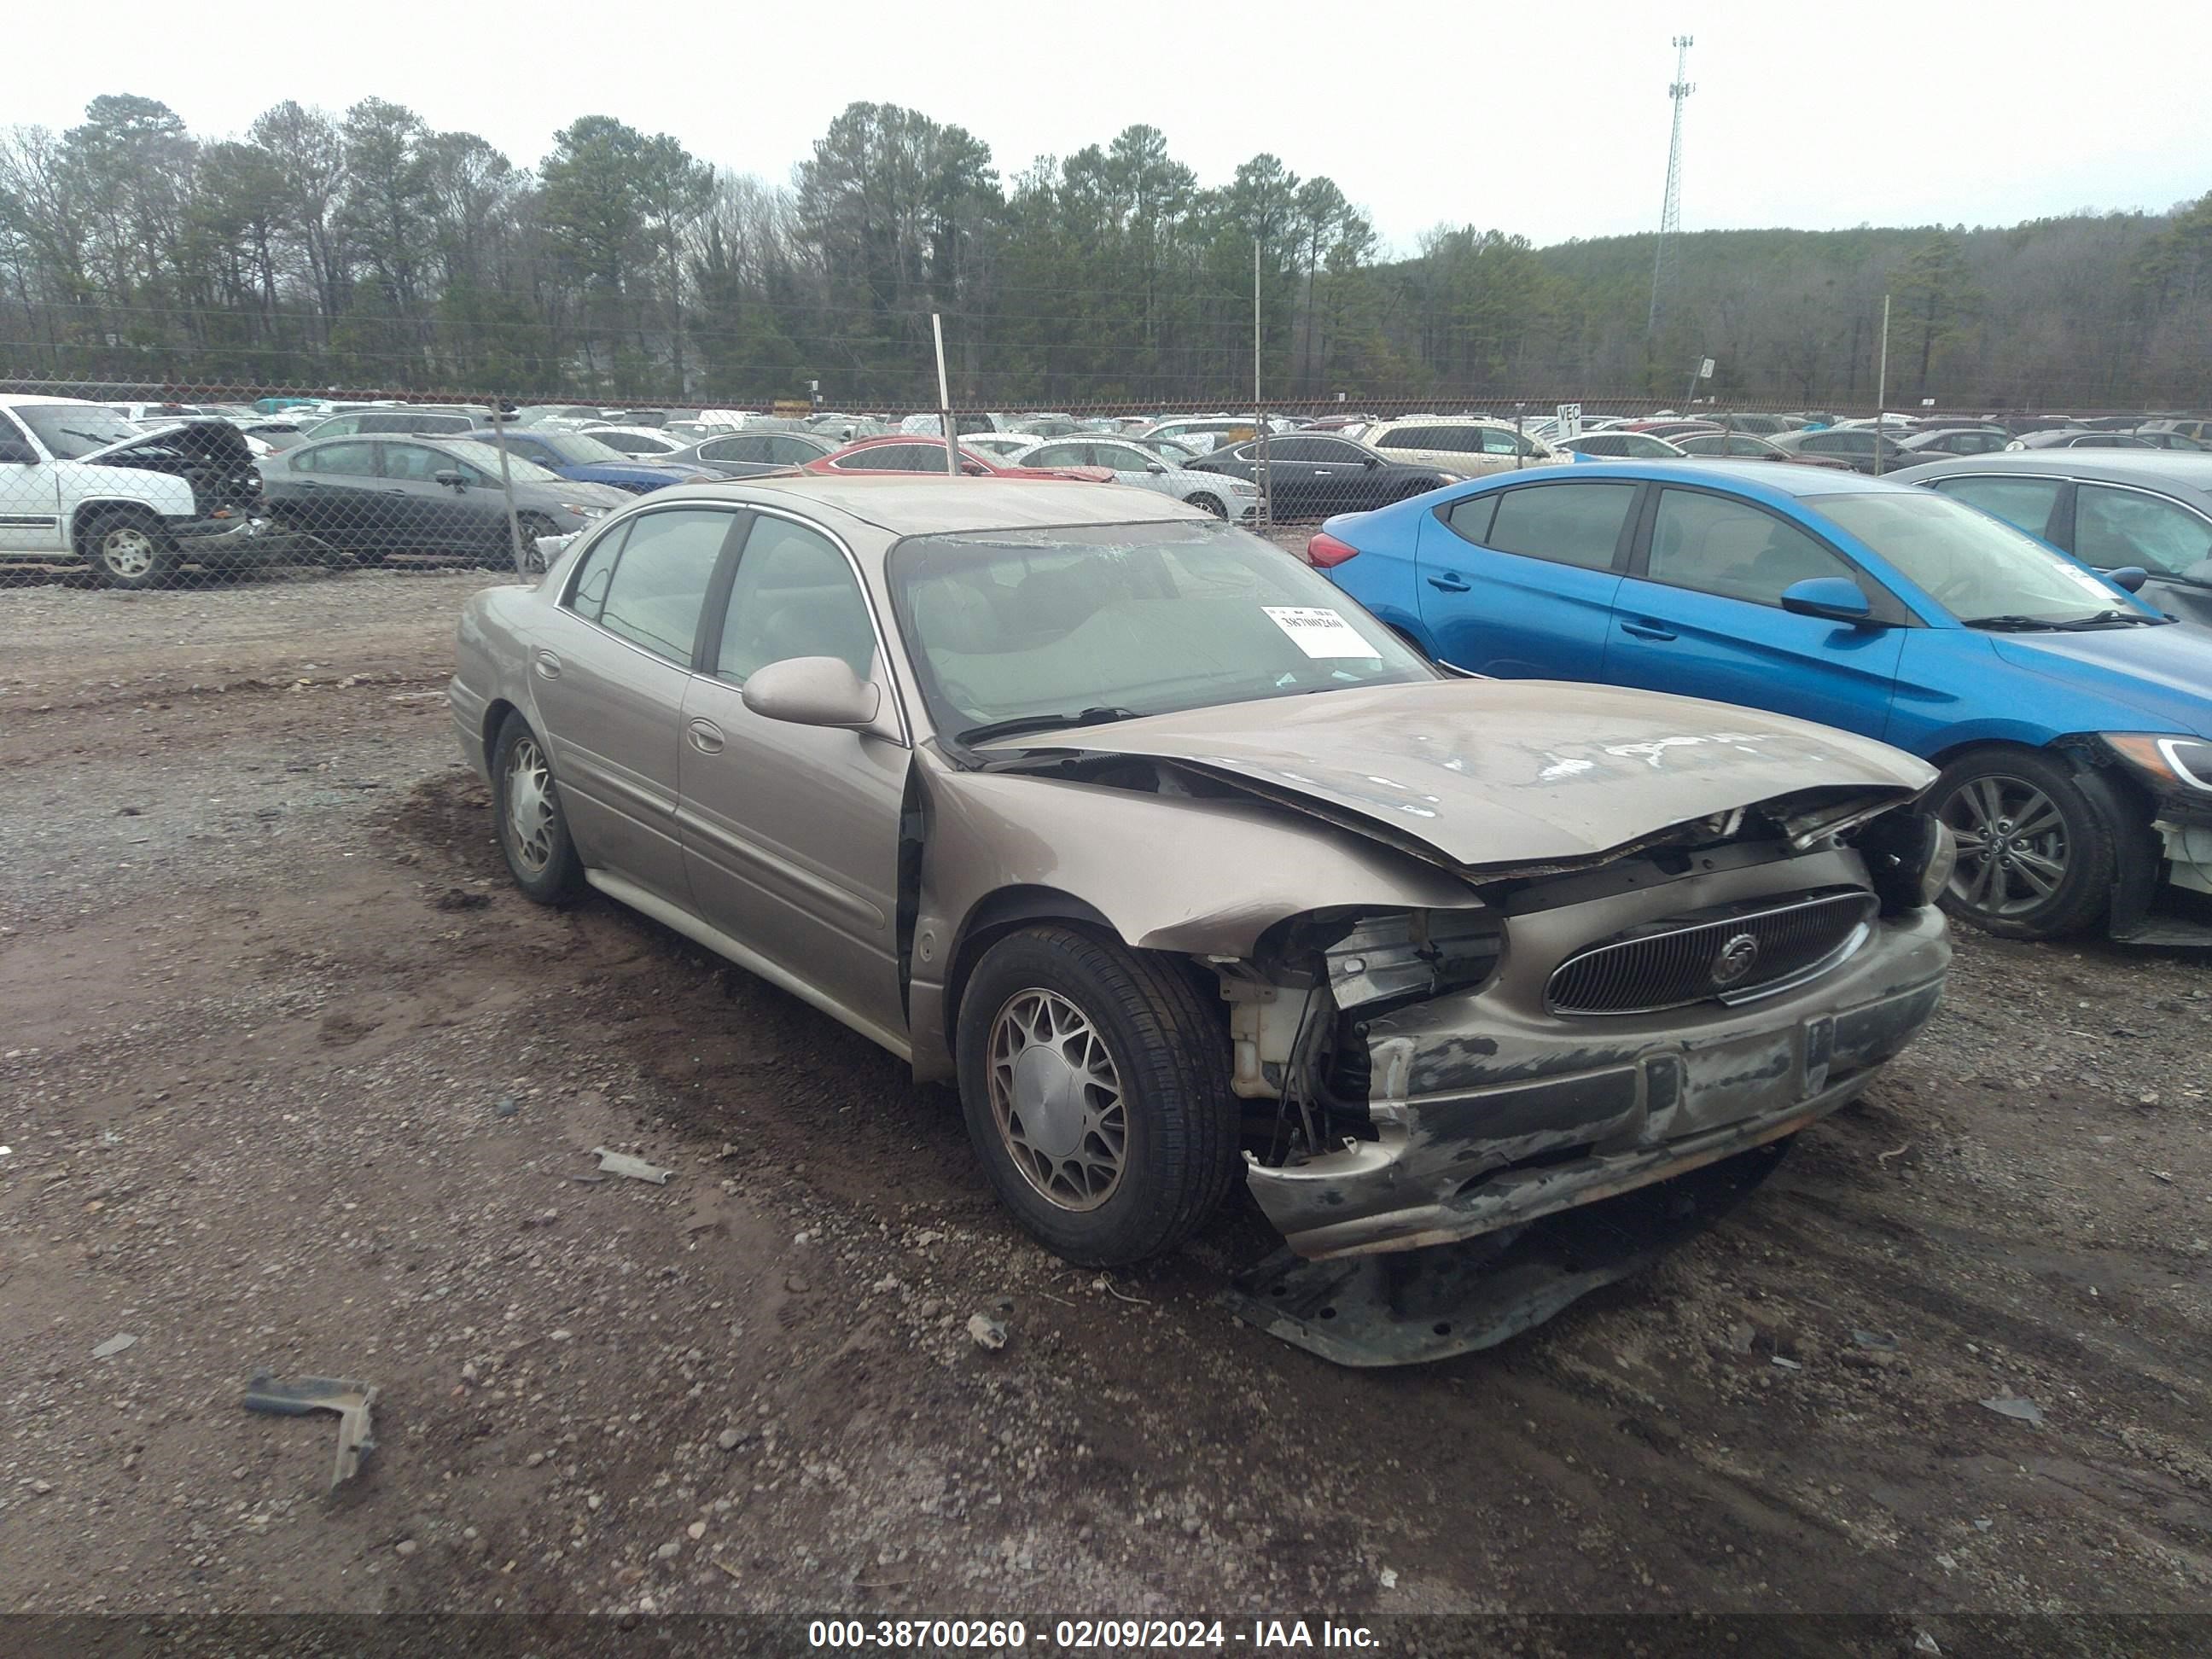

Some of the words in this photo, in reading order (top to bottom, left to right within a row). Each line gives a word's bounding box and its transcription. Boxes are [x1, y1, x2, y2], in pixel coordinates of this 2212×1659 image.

[1558, 405, 1580, 421] VEC
[1567, 422, 1574, 437] 1
[1281, 616, 1344, 628] 38700260
